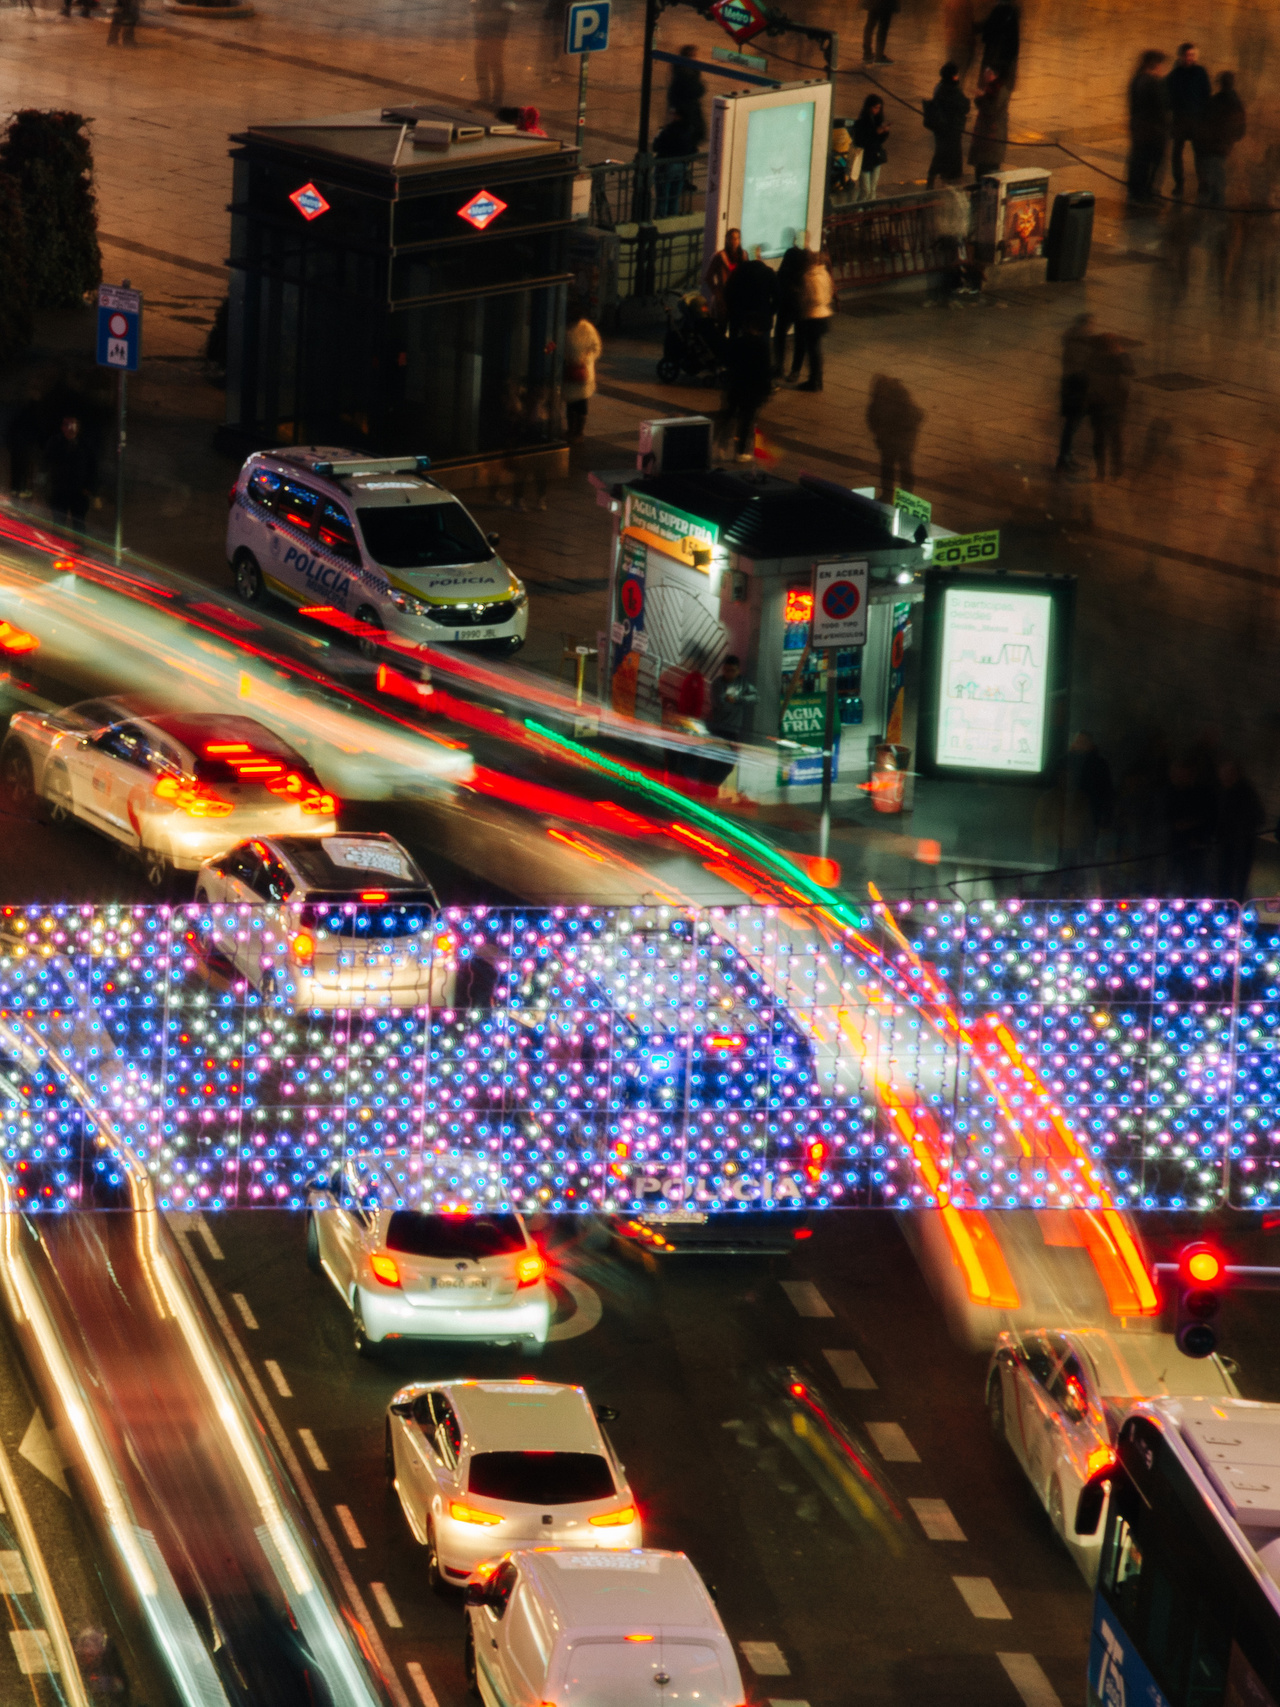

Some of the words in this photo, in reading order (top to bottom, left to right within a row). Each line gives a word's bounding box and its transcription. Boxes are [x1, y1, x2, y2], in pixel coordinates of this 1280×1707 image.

[724, 5, 749, 23] Metro
[574, 9, 600, 49] P
[300, 194, 320, 210] Metro
[472, 203, 494, 216] Metro
[632, 499, 657, 519] AGUA
[659, 510, 689, 534] SUPER
[936, 538, 971, 549] Bebidas
[936, 543, 996, 562] €0,50
[819, 571, 832, 579] EN
[836, 569, 865, 578] ACERA
[782, 707, 823, 721] AGUA
